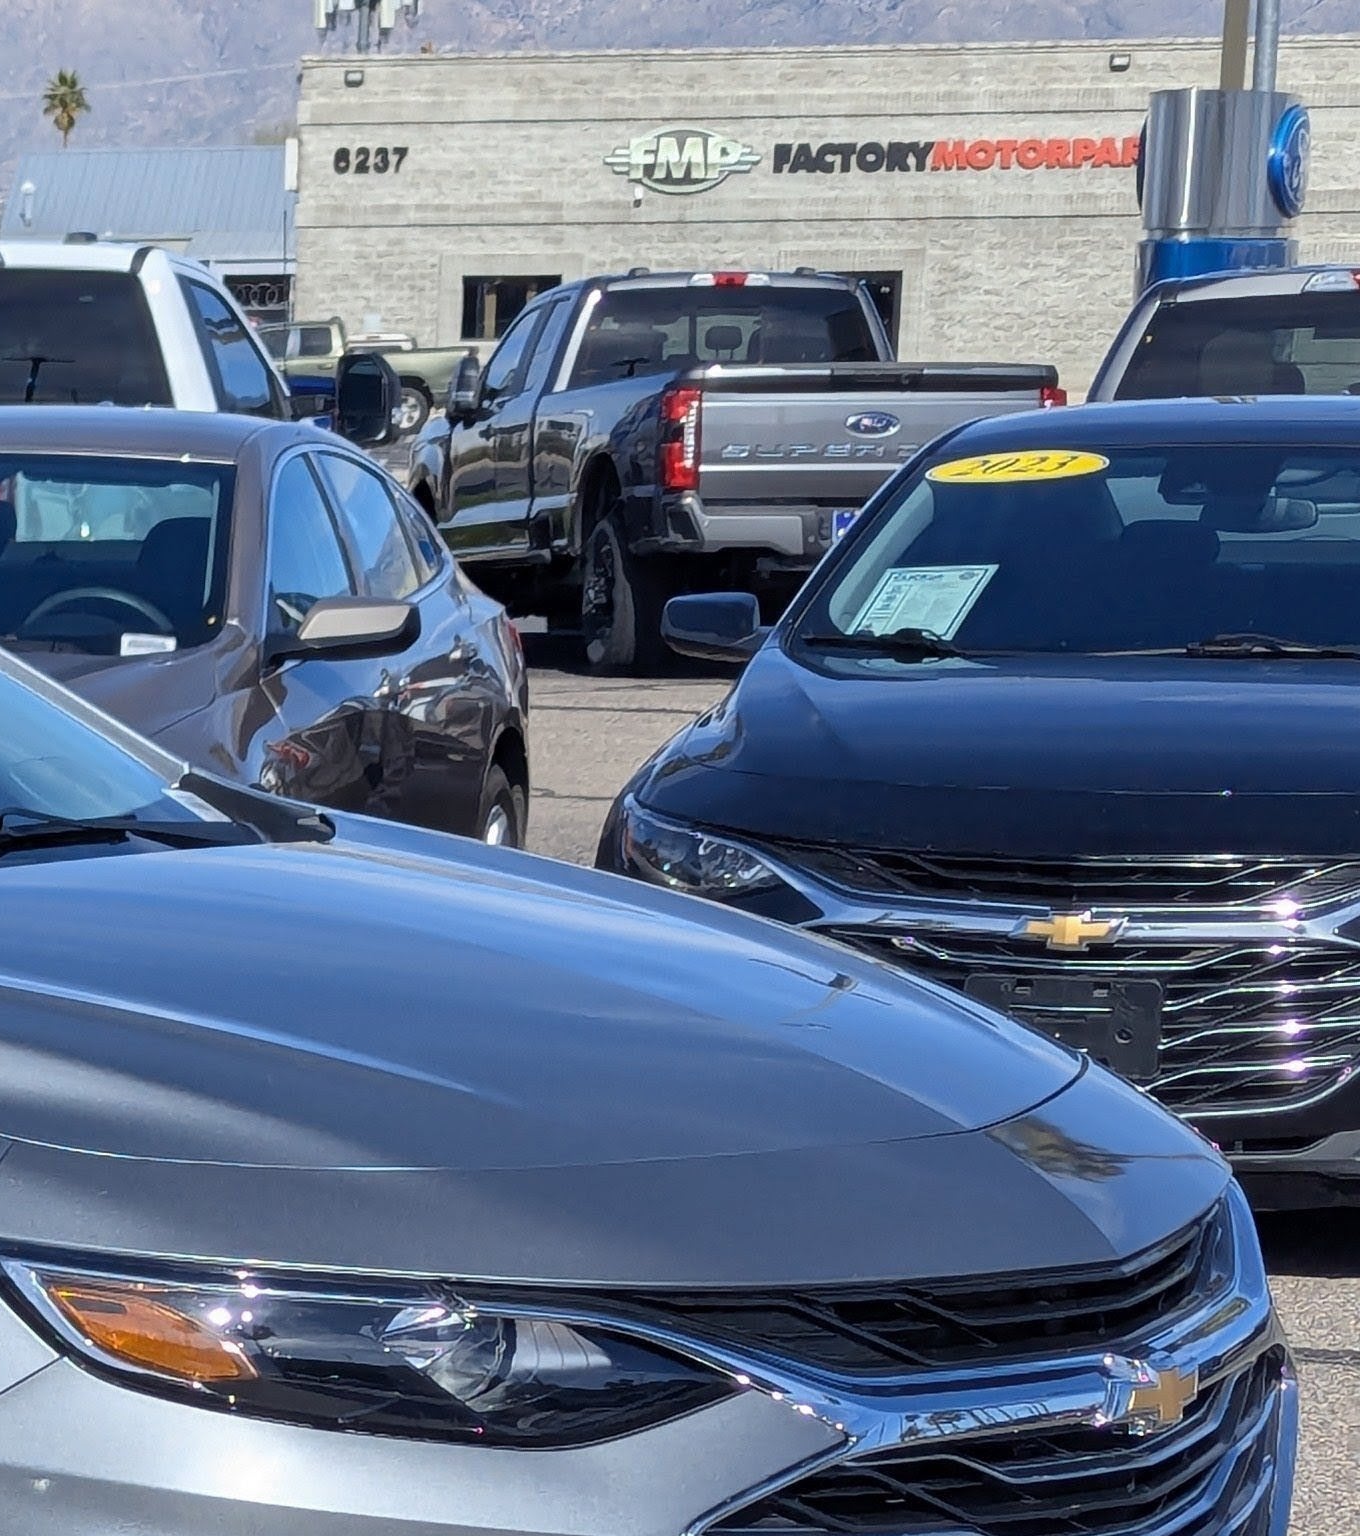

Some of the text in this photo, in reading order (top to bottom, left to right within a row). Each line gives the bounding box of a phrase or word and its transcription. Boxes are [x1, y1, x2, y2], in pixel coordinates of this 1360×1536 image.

[333, 147, 408, 175] 6237
[630, 137, 742, 179] FMP
[950, 456, 1078, 477] 2023
